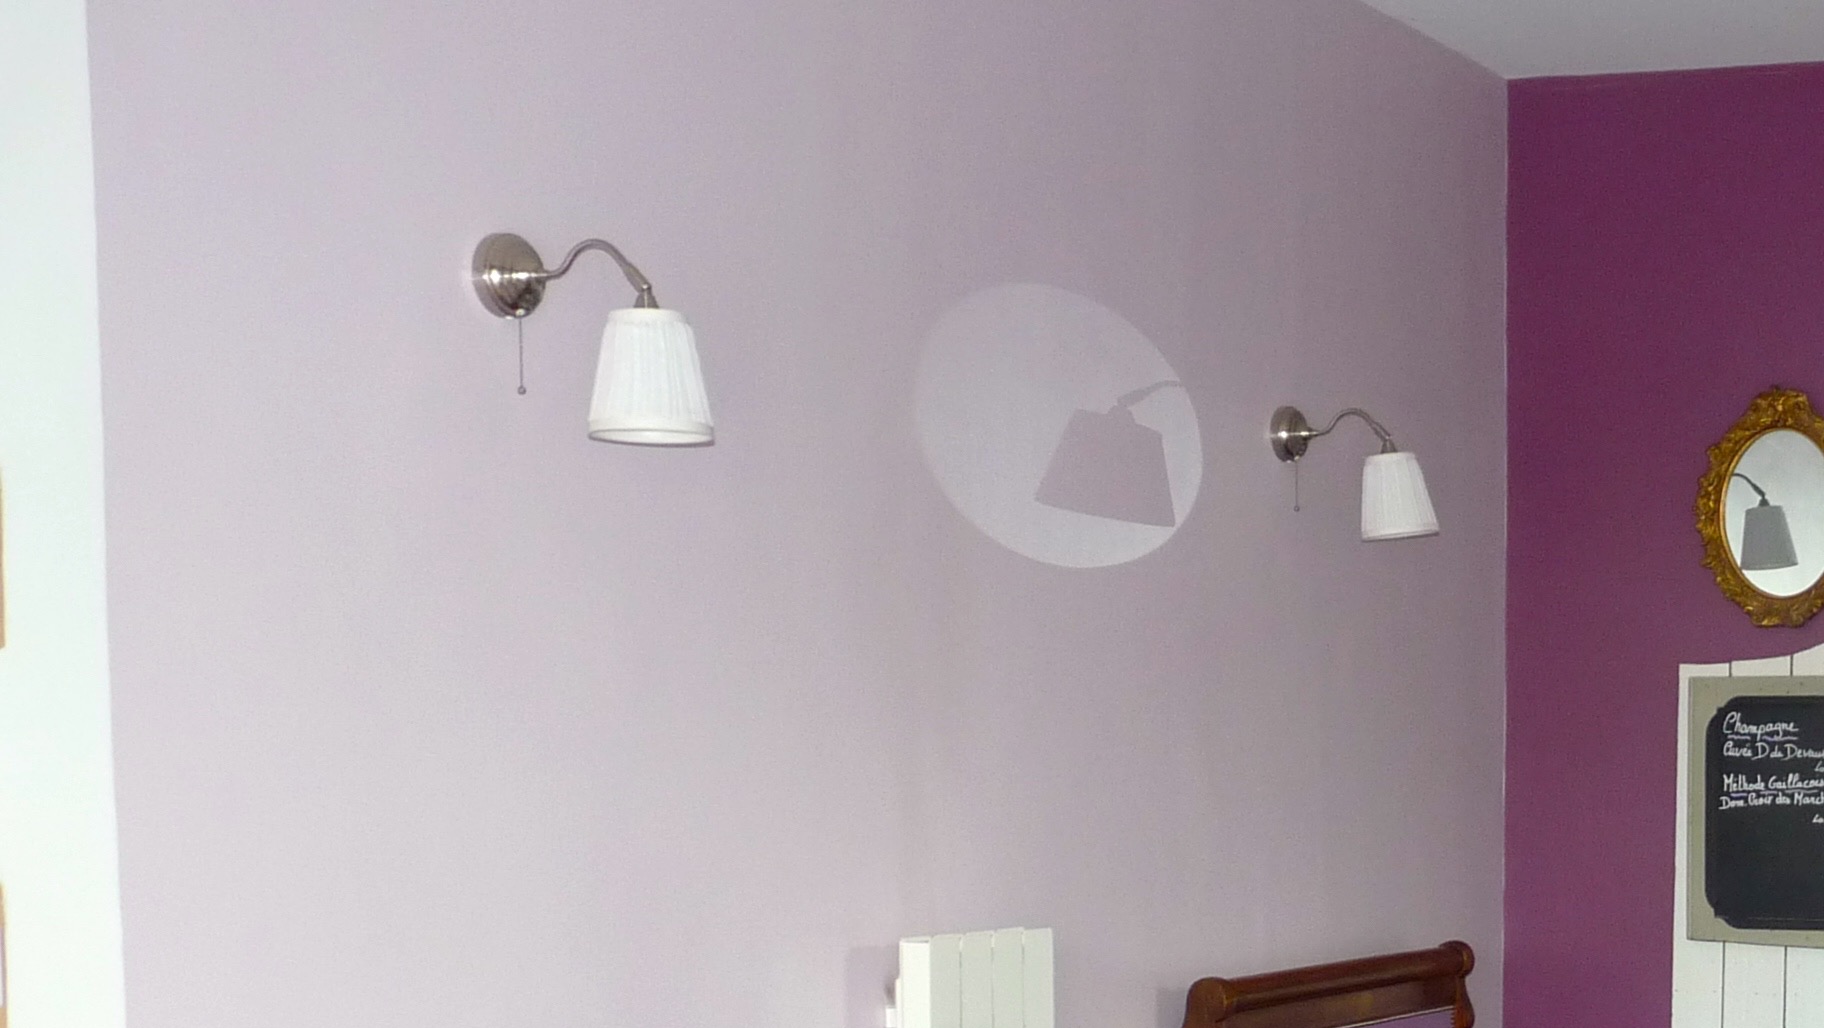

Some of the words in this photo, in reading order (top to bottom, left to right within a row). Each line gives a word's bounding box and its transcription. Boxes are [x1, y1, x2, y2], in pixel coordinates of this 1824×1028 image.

[1723, 712, 1799, 741] Champagne
[1752, 742, 1769, 760] D
[1770, 745, 1783, 758] de
